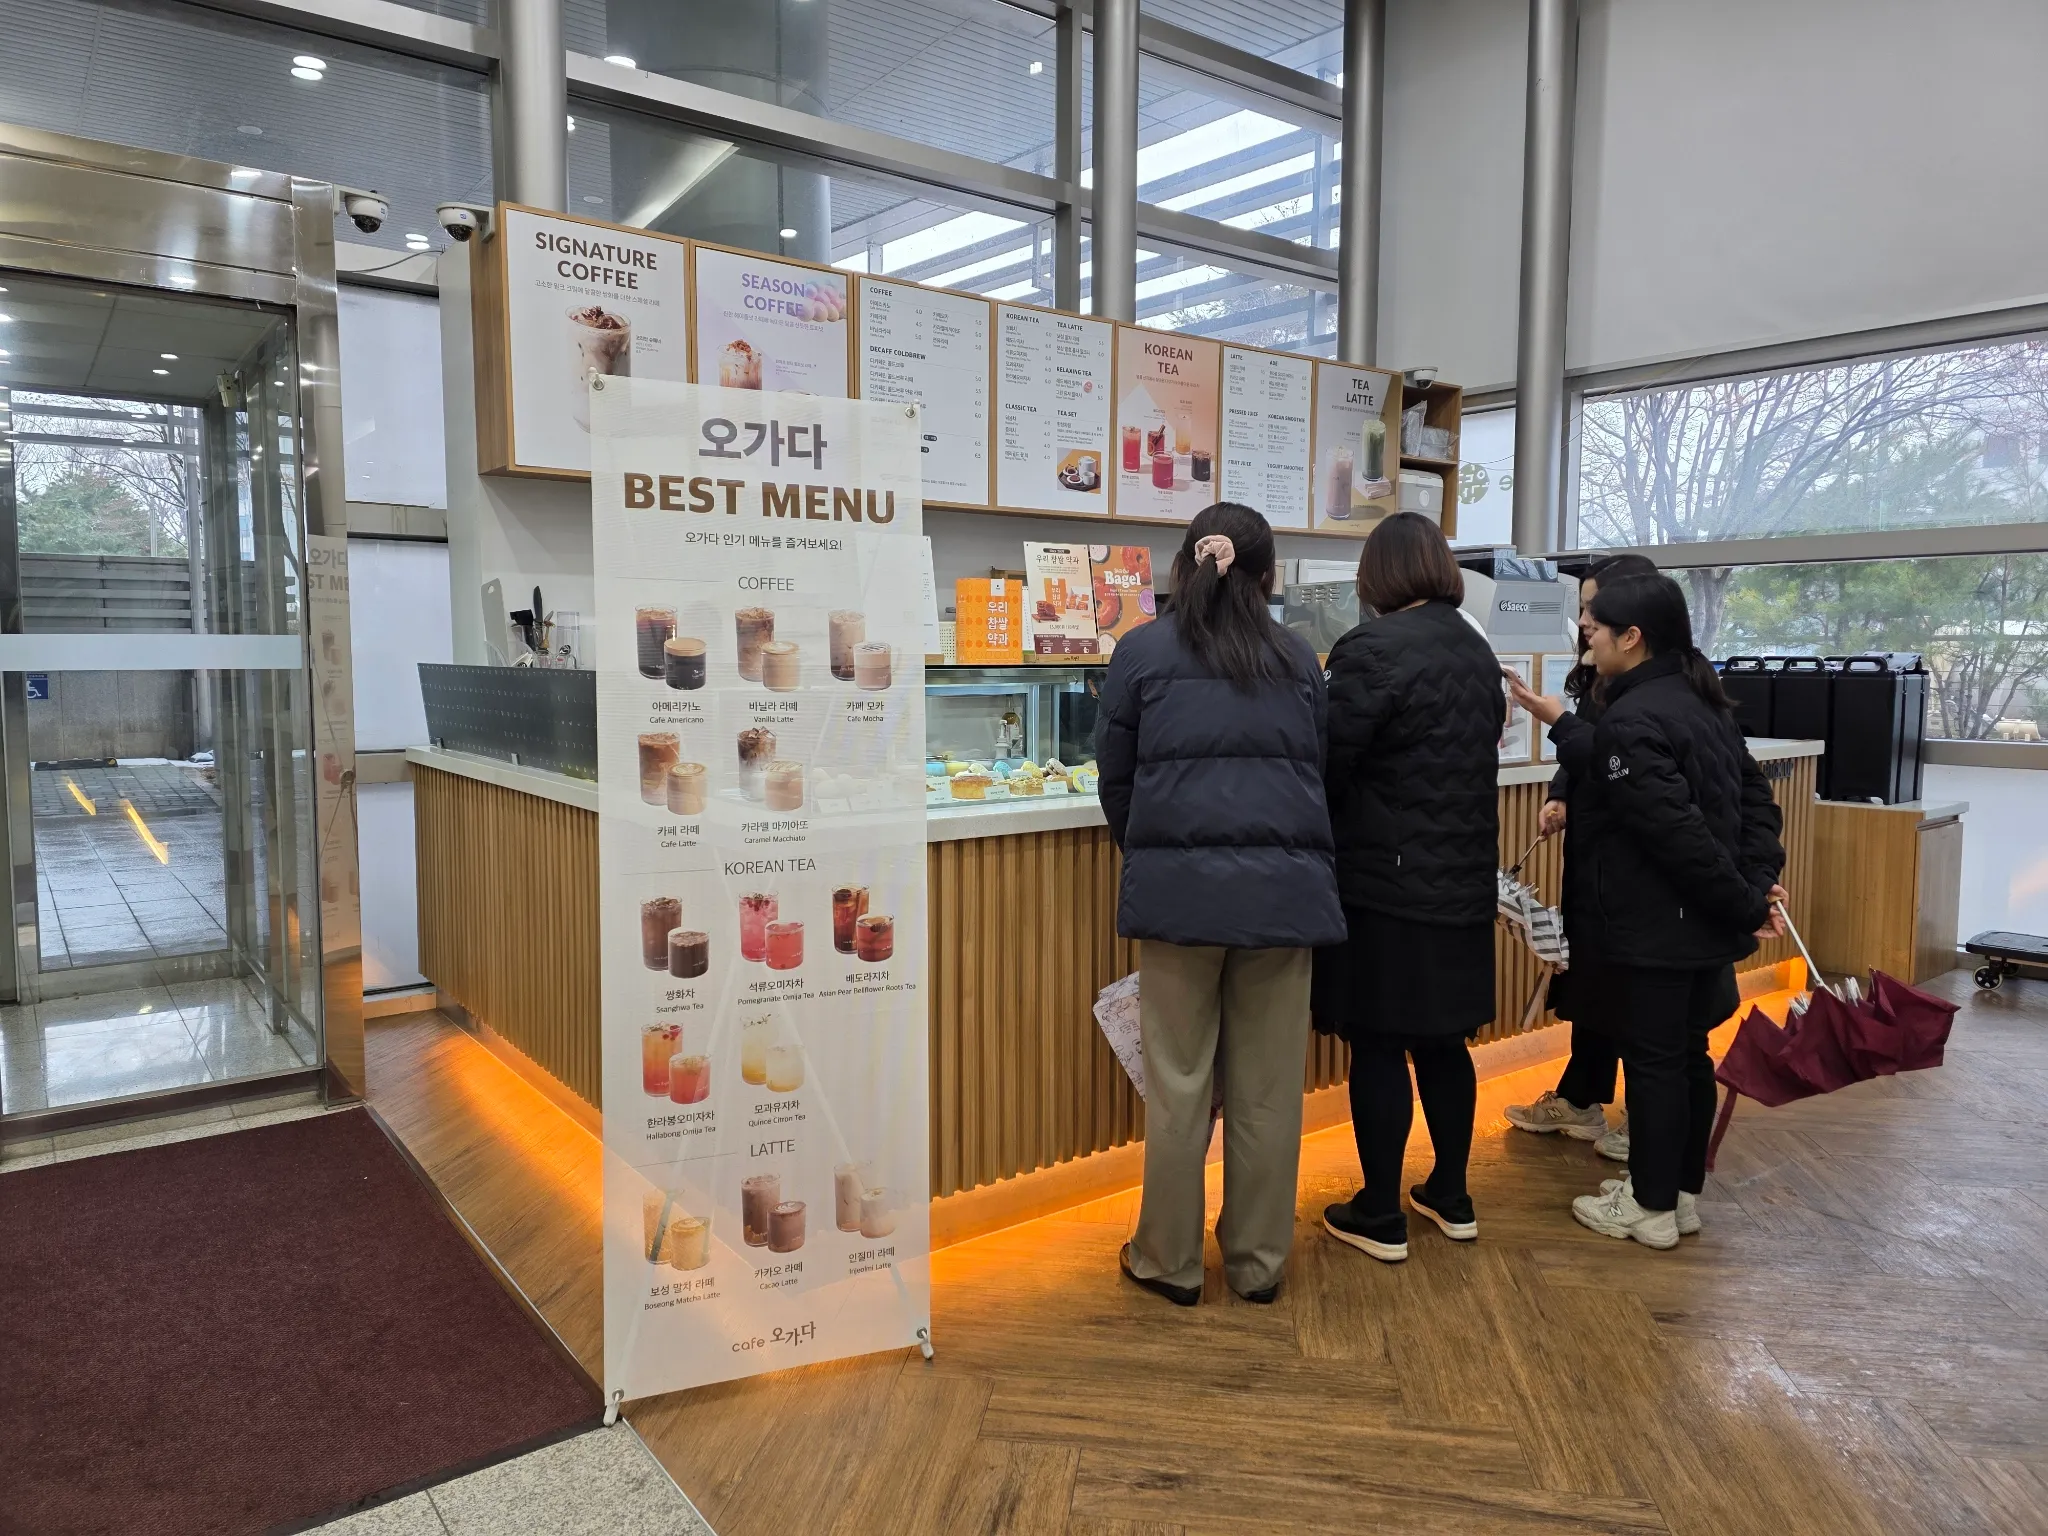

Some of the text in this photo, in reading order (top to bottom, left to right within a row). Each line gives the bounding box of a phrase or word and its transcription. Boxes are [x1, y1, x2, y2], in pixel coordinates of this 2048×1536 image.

[535, 232, 657, 270] SIGNATURE
[557, 260, 638, 290] COFFEE
[534, 280, 553, 289] 고소한
[742, 273, 805, 297] SEASON
[870, 287, 892, 296] COFFEE
[744, 295, 804, 317] COFFEE
[1006, 313, 1029, 322] KOREAN
[1068, 323, 1083, 331] LATTE
[870, 346, 926, 360] DECAFF COLDBREW
[1144, 343, 1193, 361] KOREAN
[1158, 361, 1179, 375] TEA
[1352, 378, 1370, 390] TEA
[1346, 393, 1374, 406] LATTE
[1005, 403, 1026, 411] CLASSIC
[699, 418, 827, 470] 오가다
[624, 472, 895, 524] BEST MENU
[685, 532, 842, 551] 오가다 인기 메뉴를 즐겨보세요!
[1036, 554, 1048, 563] 우리
[1066, 556, 1079, 564] 약과
[738, 576, 795, 591] COFFEE
[1104, 571, 1141, 588] Bagel
[988, 601, 1008, 614] 우리
[1507, 601, 1528, 612] Saeco
[988, 617, 1008, 630] 찹쌀
[987, 633, 1008, 646] 약과
[652, 701, 701, 712] 아메리카노
[749, 701, 798, 712] 바닐라 라떼
[846, 701, 884, 711] 카페 모카
[667, 716, 704, 724] Americano
[657, 824, 700, 836] 카페 라떼
[741, 820, 808, 832] 카라멜 마끼아또
[744, 835, 806, 844] Caramel Macchiato
[724, 858, 816, 876] KOREAN TEA
[846, 971, 890, 983] 배도라지차
[748, 978, 804, 993] 석류오미자차
[854, 986, 884, 994] Bellflower
[665, 988, 695, 1000] 쌍화차
[737, 995, 781, 1005] Pomegranate
[782, 993, 802, 1002] Omija
[656, 1004, 690, 1013] Ssanghwa
[754, 1100, 800, 1115] 모과유자차
[646, 1110, 715, 1129] 한라봉오미자차
[748, 1118, 772, 1128] Quince
[773, 1116, 793, 1124] Citron
[646, 1130, 681, 1141] Hallabong
[682, 1127, 702, 1136] Omija
[750, 1139, 795, 1157] LATTE
[848, 1246, 895, 1264] 인절미 라떼
[754, 1262, 803, 1279] 카카오 라떼
[849, 1262, 891, 1275] Injeolmi Latte
[650, 1277, 714, 1297] 보성 말차 라떼
[759, 1278, 798, 1290] Cacao Latte
[644, 1292, 721, 1310] Boseong Matcha Latte
[732, 1337, 765, 1352] cafe
